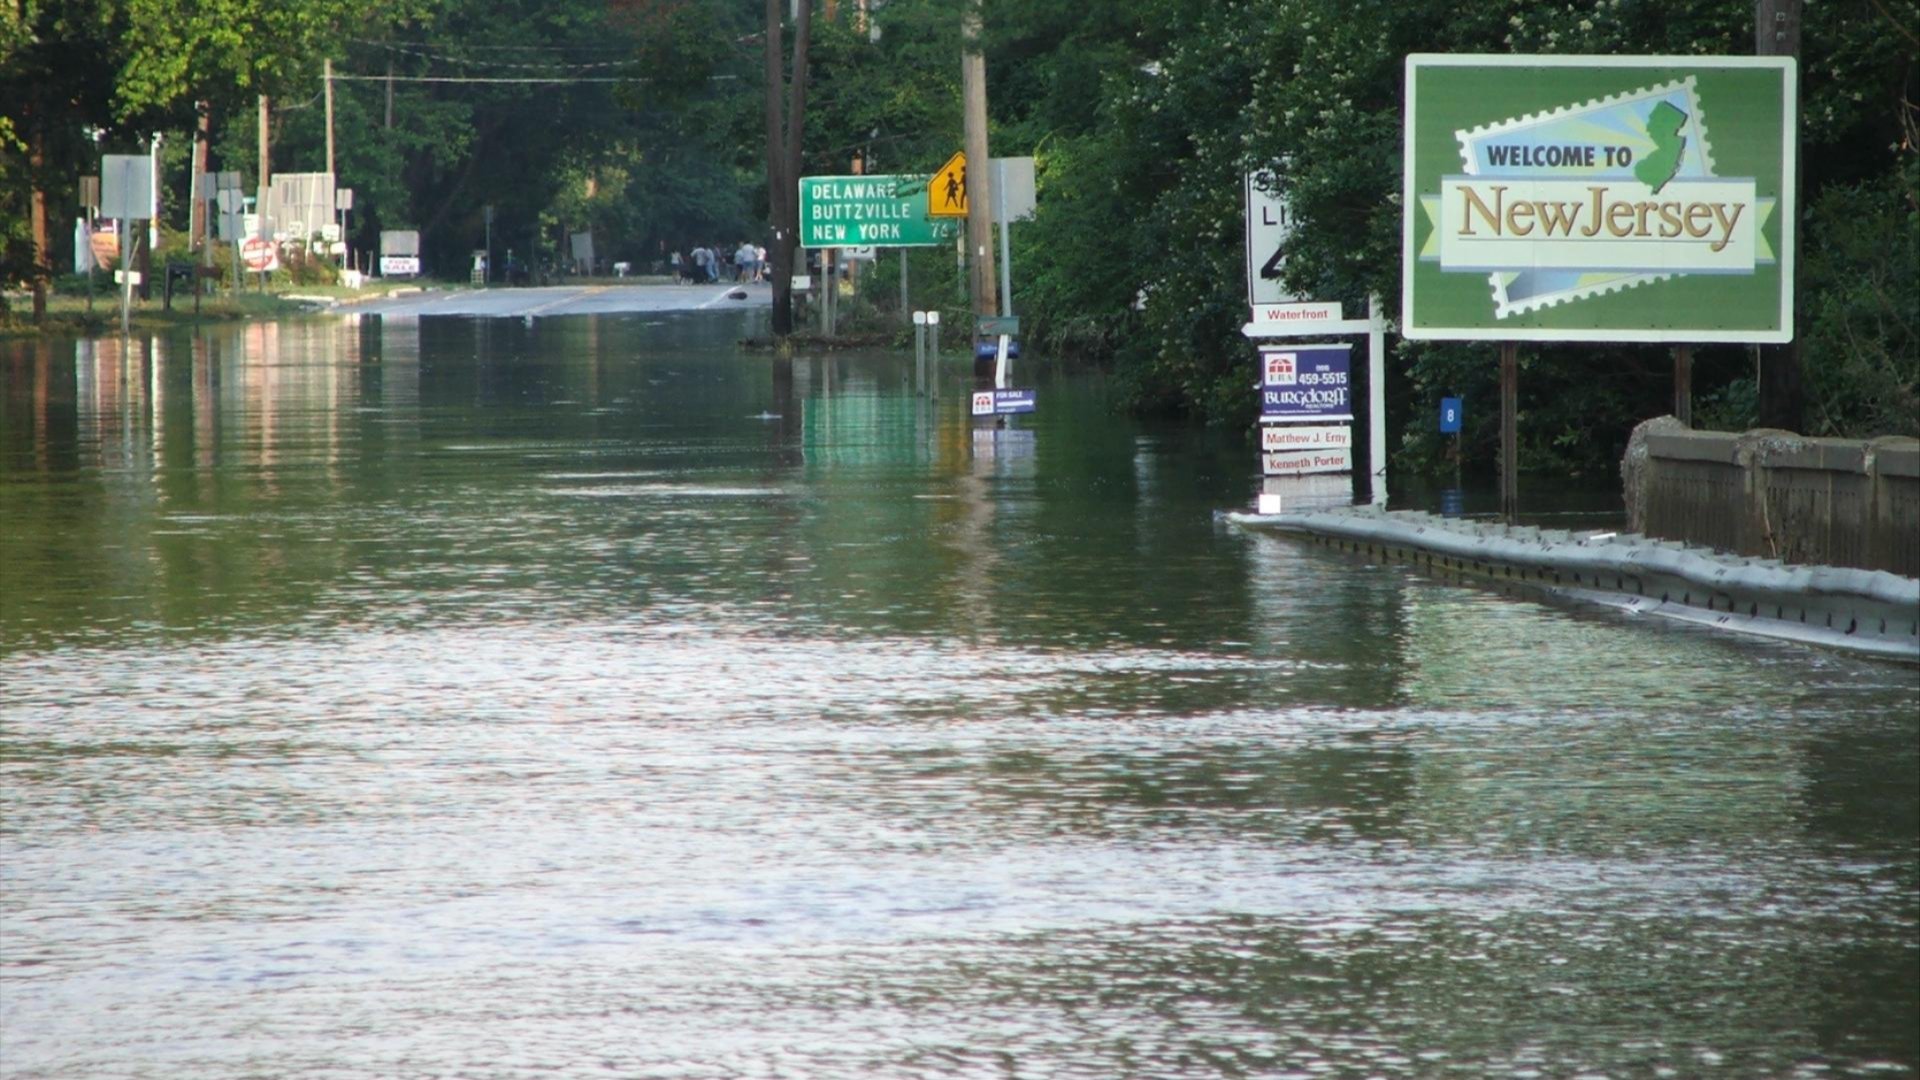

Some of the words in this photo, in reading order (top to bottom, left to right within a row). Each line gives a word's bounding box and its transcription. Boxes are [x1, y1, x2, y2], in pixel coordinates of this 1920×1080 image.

[1487, 146, 1595, 167] WELCOME
[1604, 147, 1632, 167] TO
[812, 183, 897, 200] DELAWARE
[812, 203, 911, 219] BUTTZVILLE
[813, 224, 846, 240] NEW
[858, 223, 901, 240] YORK
[1267, 309, 1329, 321] Waterfront
[1299, 372, 1347, 385] 459-5515
[1447, 409, 1455, 422] 8
[1266, 433, 1311, 444] Matthew
[1269, 458, 1311, 469] Kenneth
[1314, 456, 1345, 466] Porter
